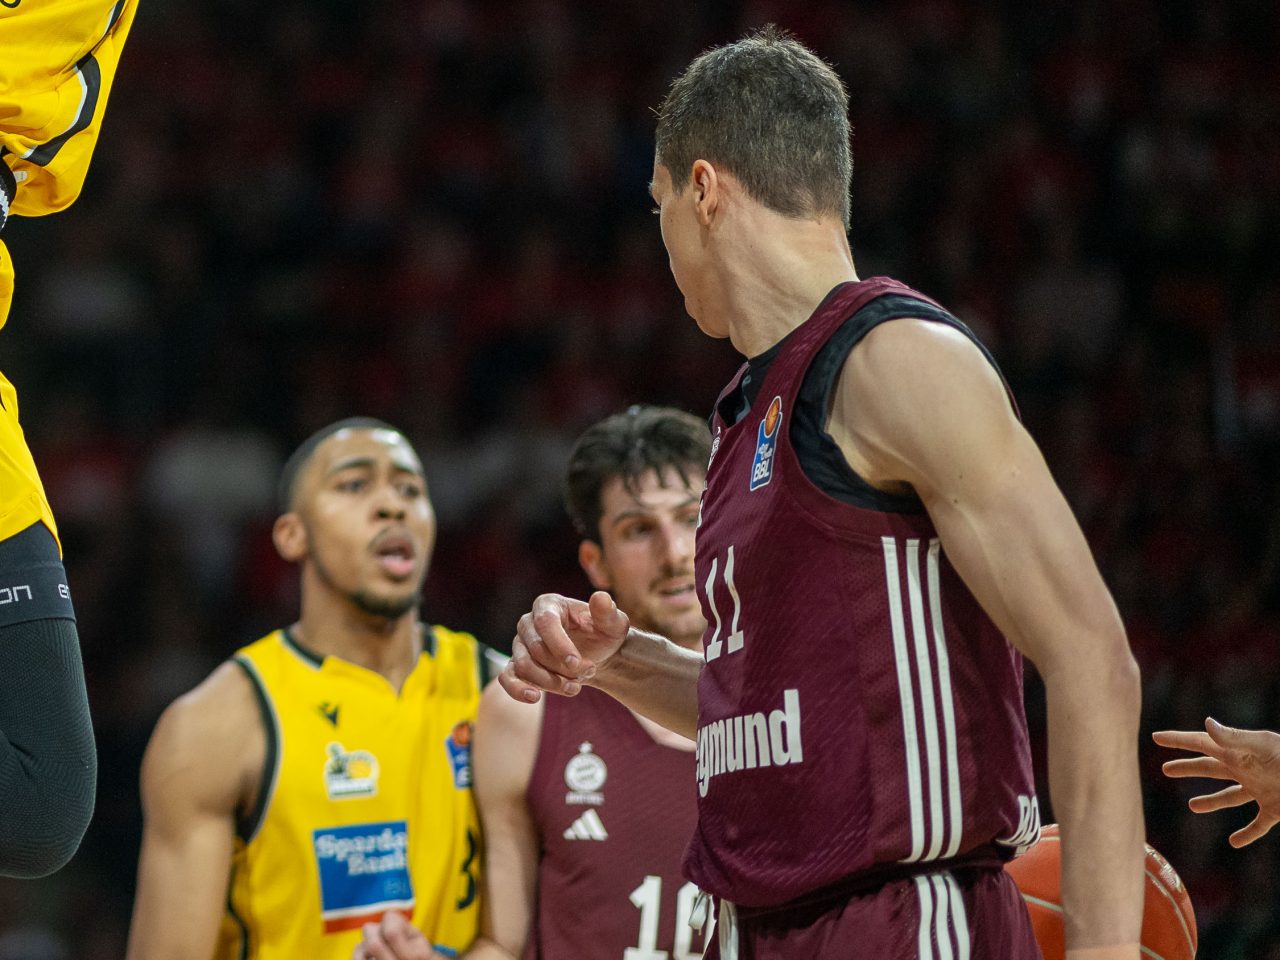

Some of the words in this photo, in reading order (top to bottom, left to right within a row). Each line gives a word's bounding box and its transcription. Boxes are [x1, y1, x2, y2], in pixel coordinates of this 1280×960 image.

[753, 457, 770, 482] BBL
[704, 545, 745, 663] 11
[696, 688, 804, 798] gmund
